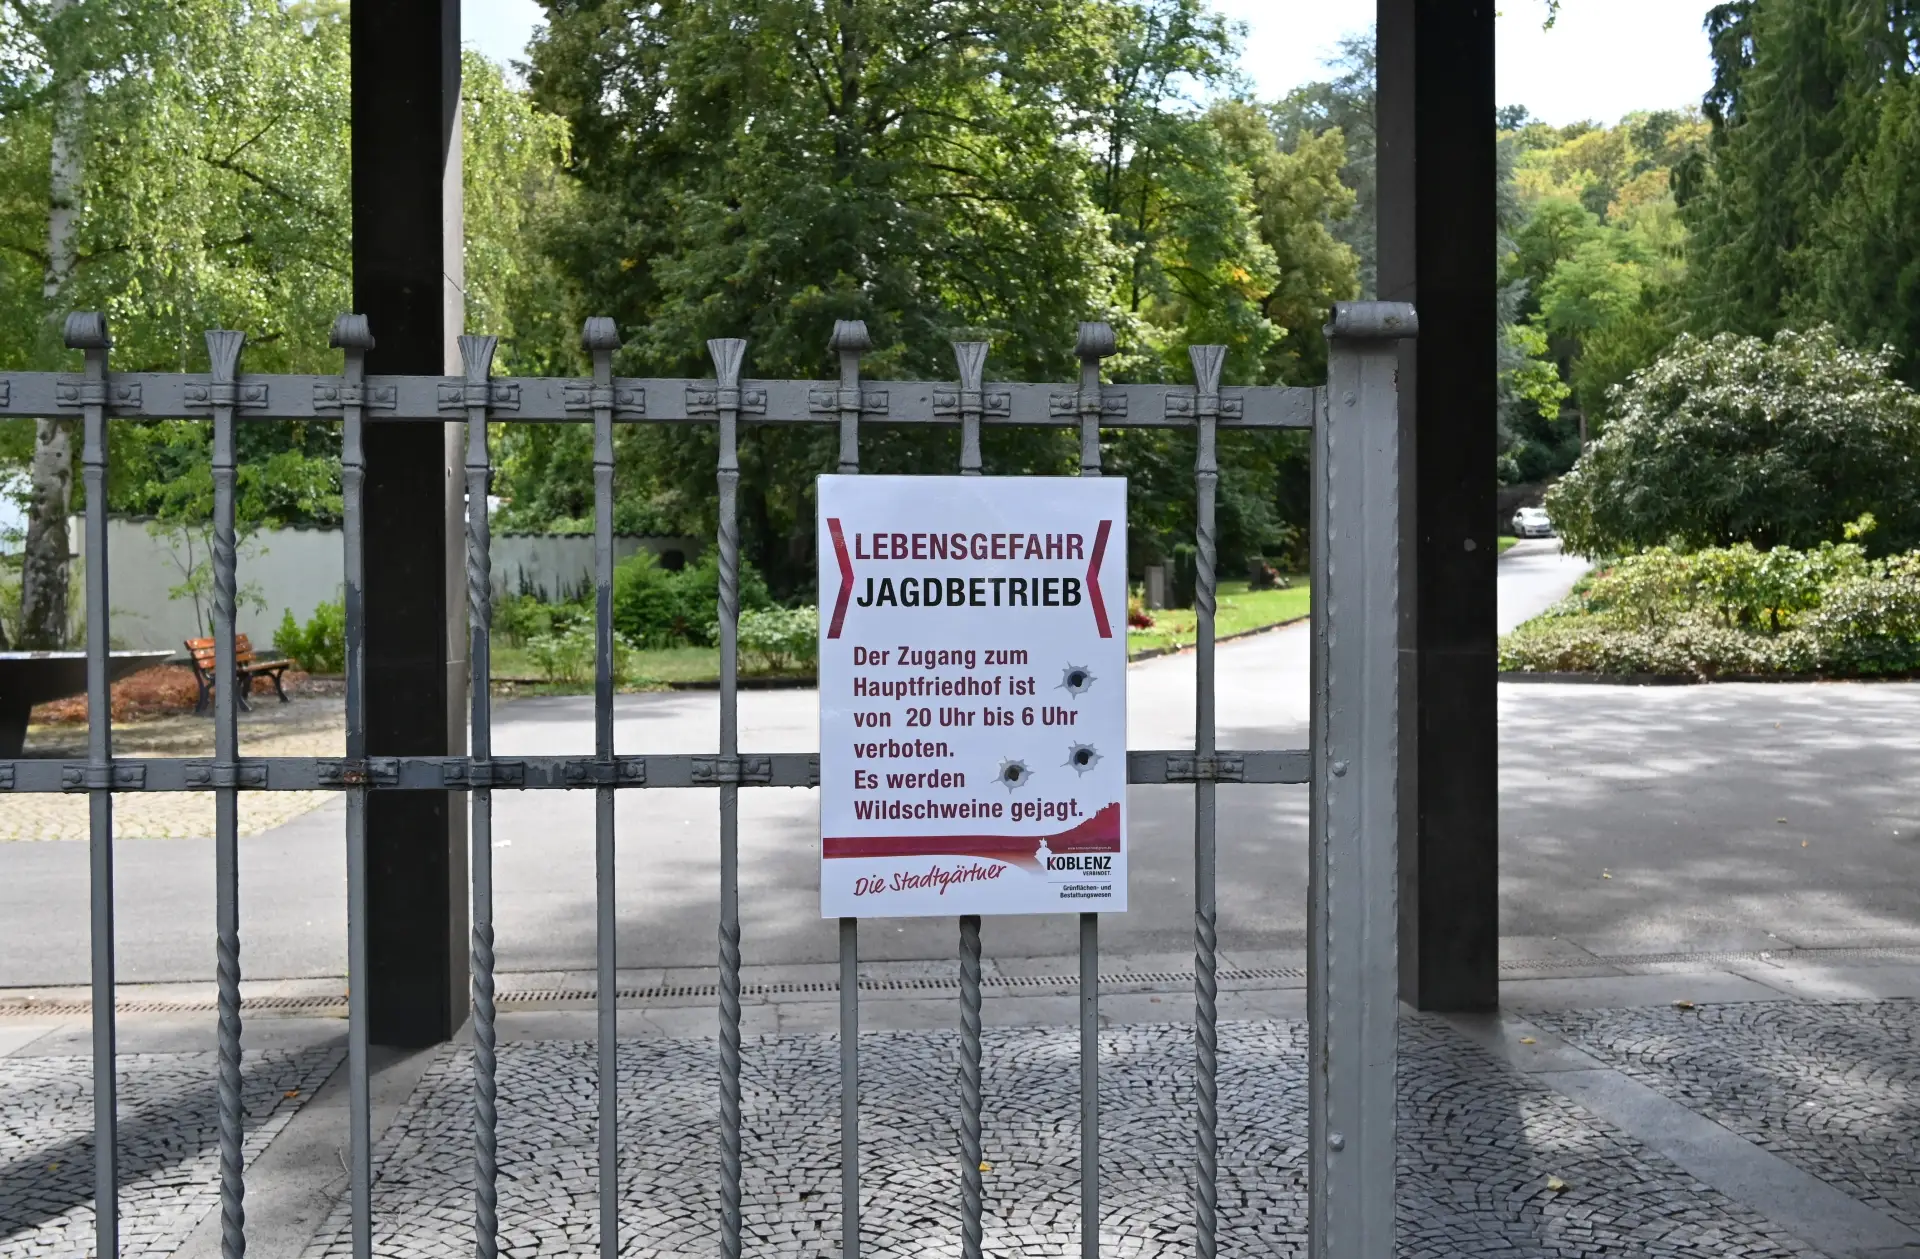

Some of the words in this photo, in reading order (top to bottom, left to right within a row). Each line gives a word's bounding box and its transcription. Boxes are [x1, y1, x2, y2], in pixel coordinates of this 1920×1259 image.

[856, 533, 1083, 560] LEBENSGEFAHR
[857, 578, 1081, 607] JAGDBETRIEB
[854, 647, 890, 665] Der
[898, 646, 975, 669] Zugang
[984, 650, 1028, 666] zum
[854, 676, 1001, 700] Hauptfriedhof
[1010, 676, 1035, 695] ist
[854, 712, 890, 727] von
[906, 708, 931, 727] 20
[940, 708, 975, 726] Uhr
[984, 707, 1014, 726] bis
[1022, 707, 1034, 726] 6
[1043, 707, 1078, 725] Uhr
[854, 739, 954, 758] verboten.
[855, 770, 878, 789] Es
[886, 769, 964, 788] werden
[854, 799, 1002, 819] Wildschweine
[1011, 799, 1083, 822] gejagt.
[1047, 856, 1111, 871] KOBLENZ
[854, 875, 886, 896] Die
[889, 863, 1007, 896] Stadtgärtner
